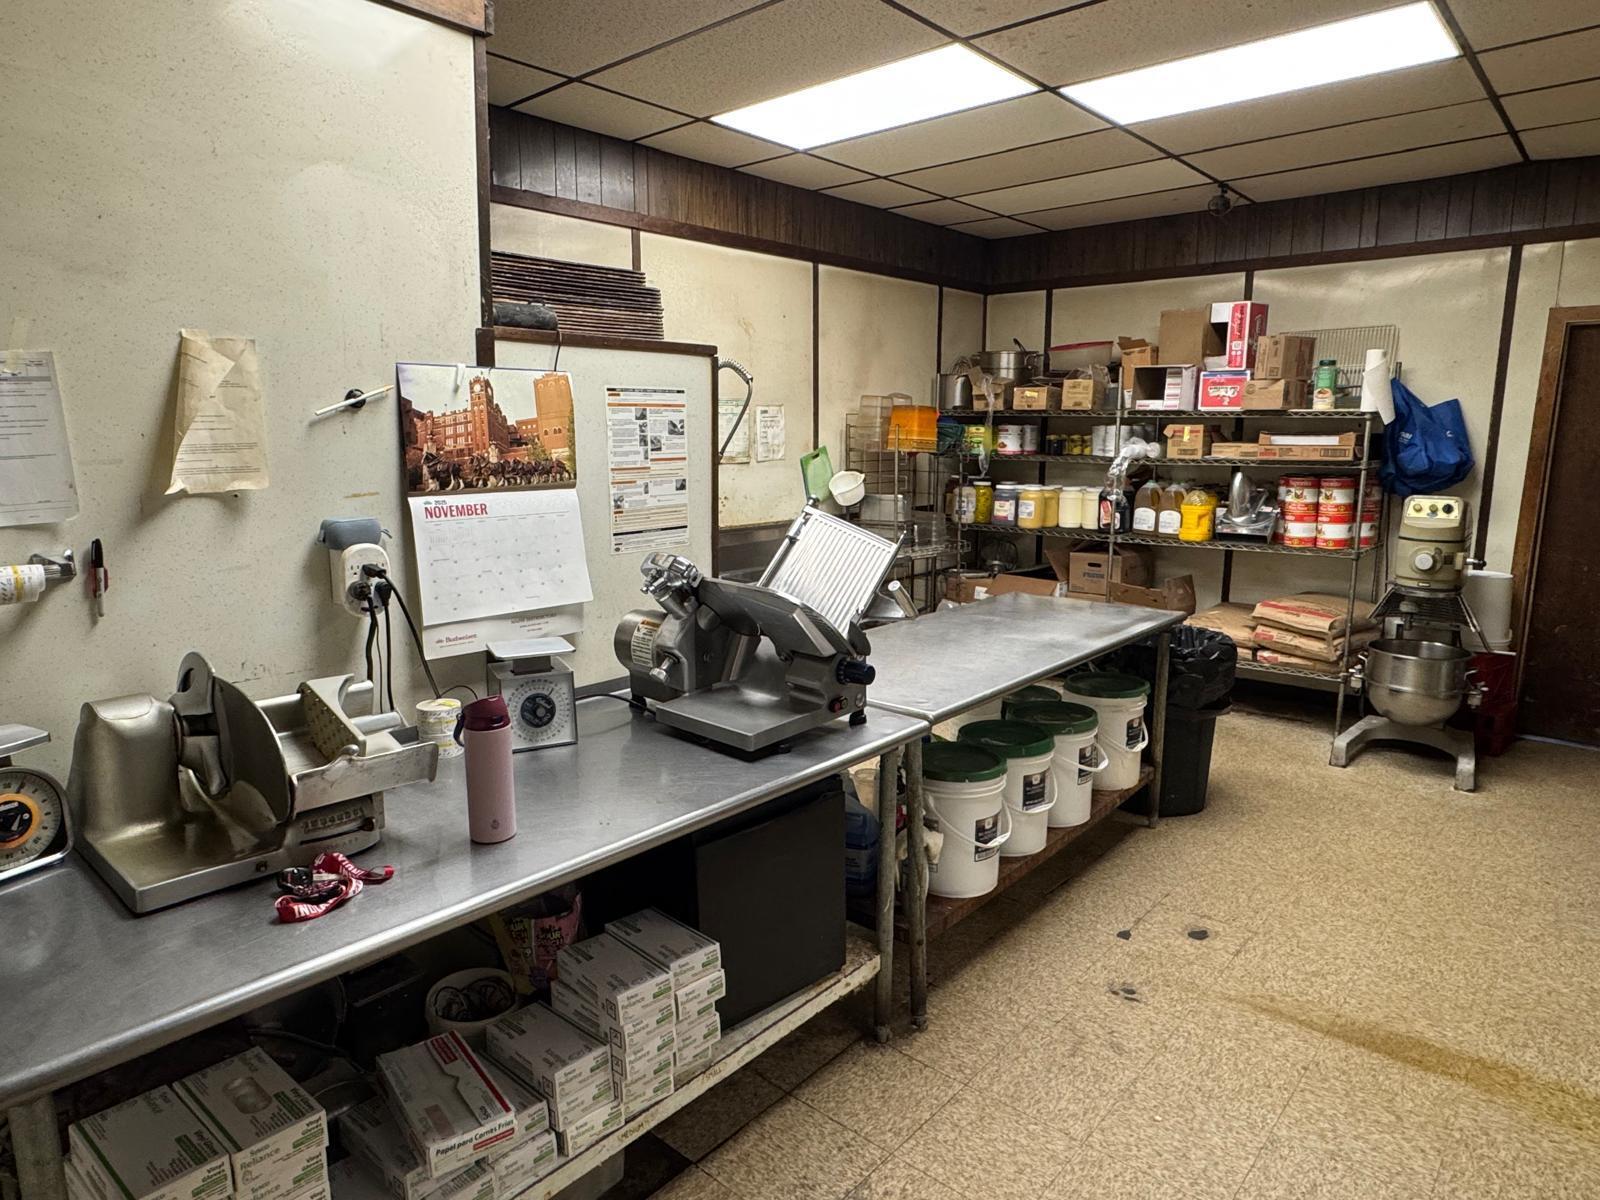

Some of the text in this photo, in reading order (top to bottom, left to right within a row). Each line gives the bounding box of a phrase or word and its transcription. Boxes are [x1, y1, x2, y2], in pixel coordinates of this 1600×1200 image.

[424, 503, 488, 518] NOVEMBER
[445, 633, 478, 644] Budweiser
[436, 1144, 456, 1156] Papel
[456, 1138, 474, 1149] para
[474, 1127, 497, 1141] Carnes
[239, 1147, 281, 1171] Reliance
